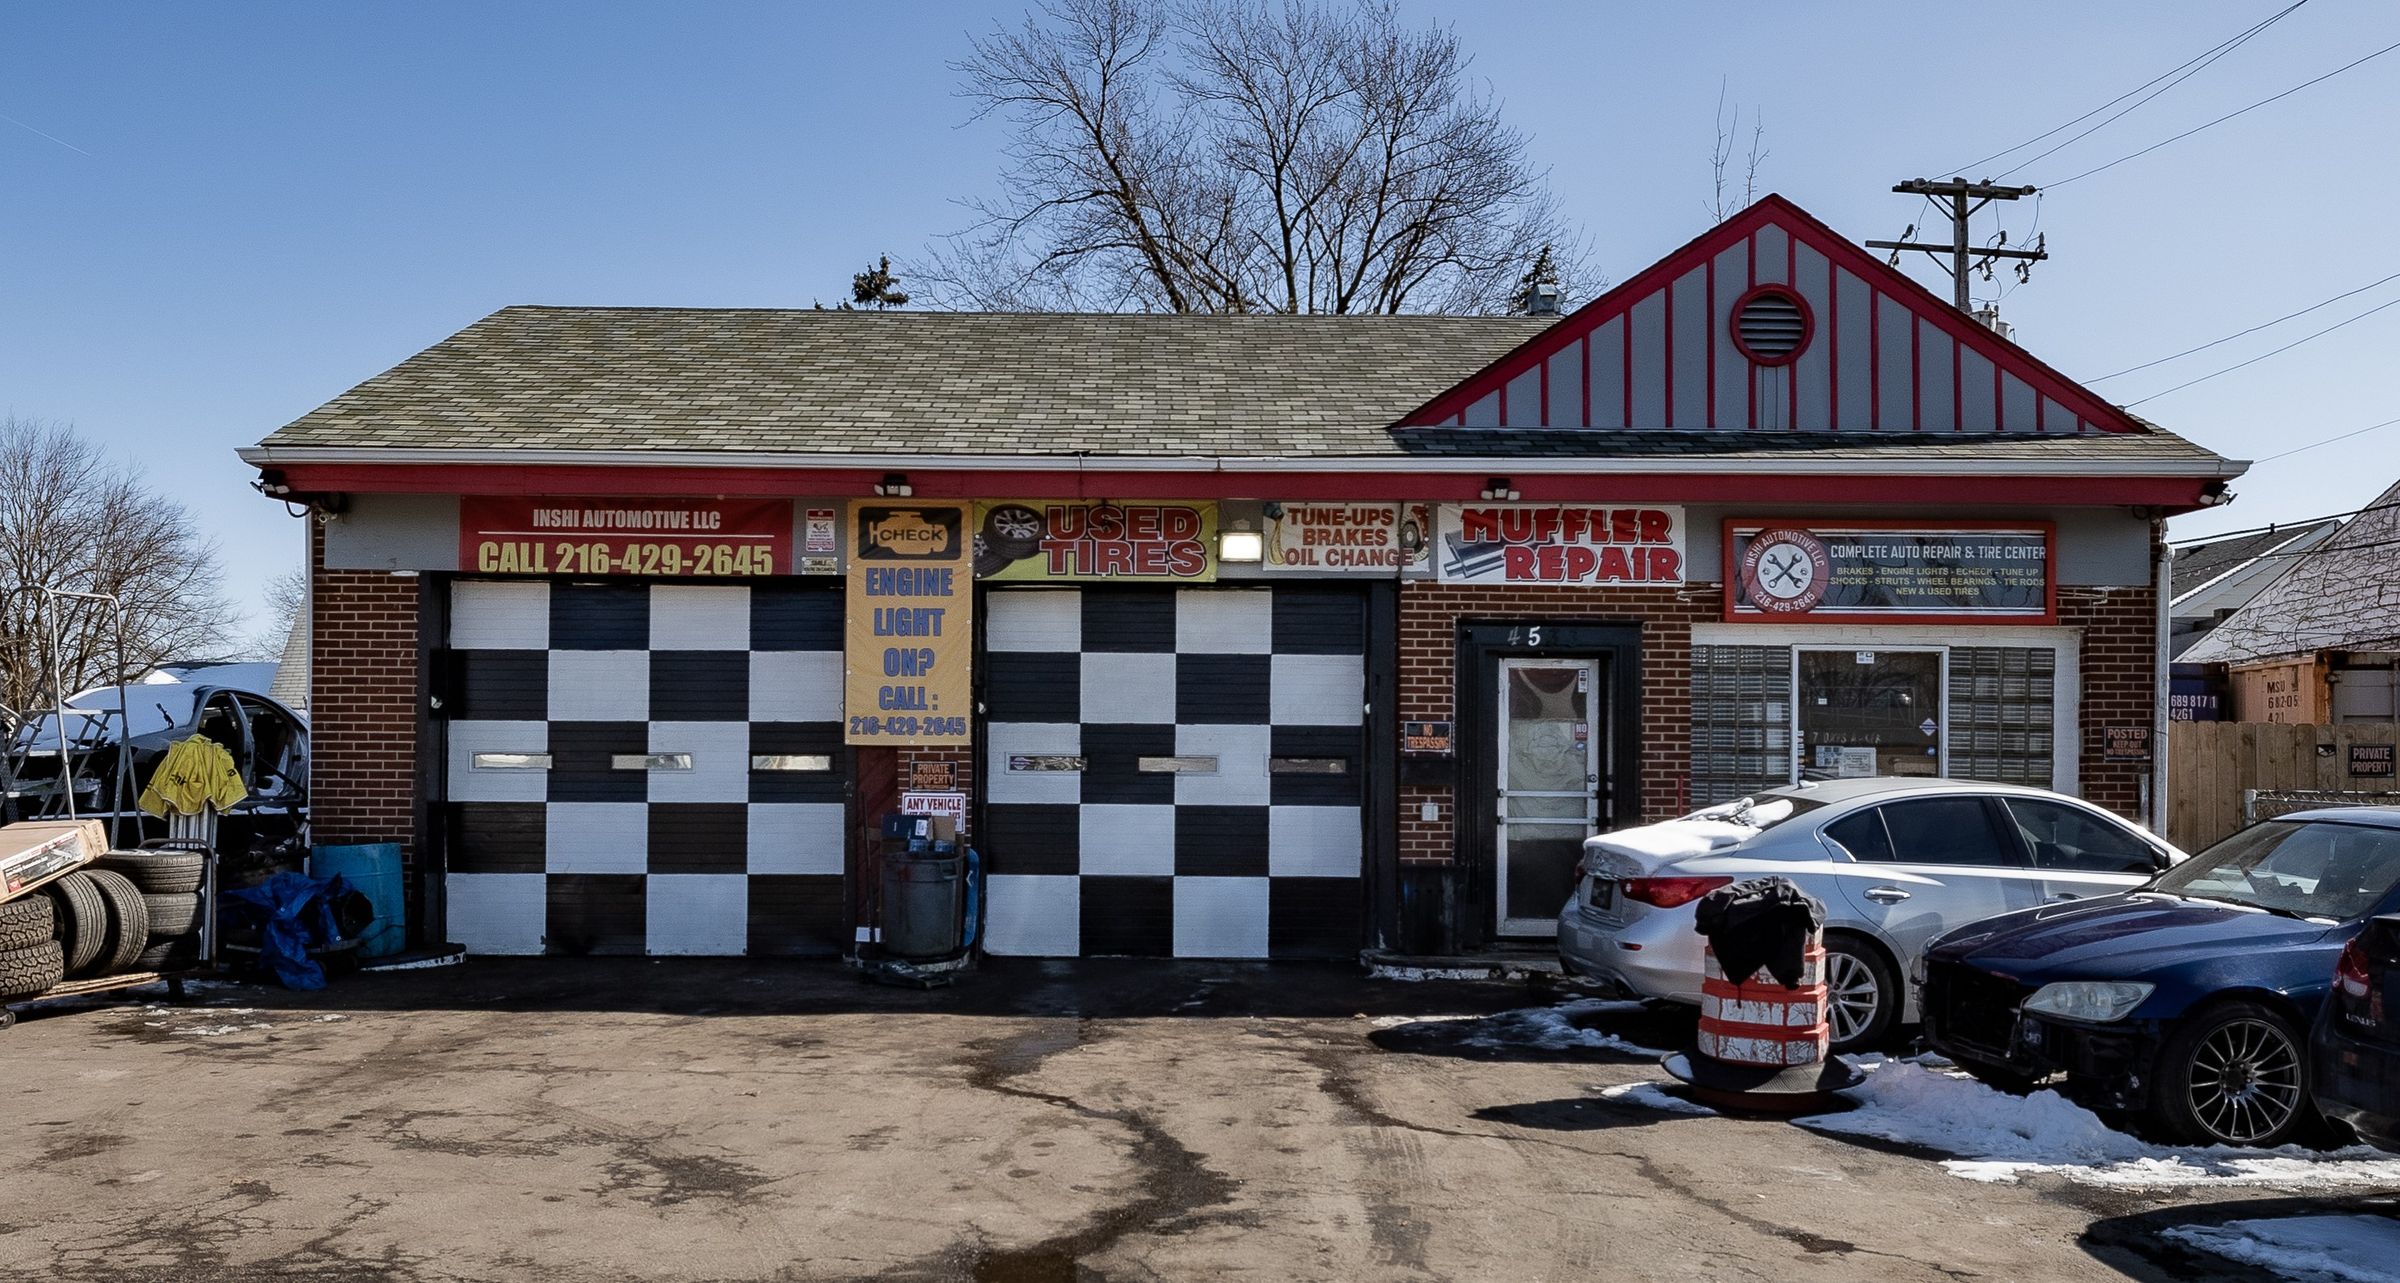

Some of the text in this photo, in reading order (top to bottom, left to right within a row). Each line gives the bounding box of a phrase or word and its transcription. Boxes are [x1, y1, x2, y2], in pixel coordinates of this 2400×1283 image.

[533, 509, 721, 530] INSHI AUTOMOTIVE LLC
[1046, 505, 1201, 542] USED
[1287, 507, 1394, 526] TUNE-UPS
[879, 529, 943, 542] CHECK
[1461, 508, 1673, 545] MUFFLER
[1302, 528, 1388, 546] BRAKES
[478, 541, 773, 575] CALL 216-429-2645
[1039, 539, 1207, 577] TIRES
[1285, 548, 1414, 566] OIL CHANGE
[1746, 531, 1825, 567] INSHI AUTOMOTIVE LLC
[1830, 545, 2046, 560] COMPLETE AUTO REPAIR & TIRE CENTER
[1502, 546, 1683, 583] REPAIR
[1837, 567, 1874, 575] BRAKES
[1881, 567, 1914, 575] ENGINE
[1916, 567, 1949, 576] LIGHTS
[1956, 568, 1993, 576] ECHECK
[2000, 568, 2024, 576] TUNE
[2026, 568, 2039, 576] UP
[865, 567, 954, 596] ENGINE
[1830, 577, 1867, 585] SHOCKS
[1875, 577, 1910, 585] STRUTS
[1917, 577, 1949, 585] WHEEL
[1950, 578, 1996, 586] BEARINGS
[2004, 578, 2018, 586] TIE
[2020, 578, 2045, 586] RODS
[1896, 587, 1916, 595] NEW
[1927, 587, 1952, 595] USED
[1954, 587, 1980, 596] TIRES
[1754, 591, 1815, 612] 216-429-2645
[873, 608, 945, 637] LIGHT
[883, 648, 935, 677] ON?
[849, 716, 967, 736] 216-429-2645
[1423, 724, 1432, 736] NO
[2108, 729, 2148, 739] POSTED
[1408, 736, 1449, 749] TRESPASSING
[2353, 747, 2390, 760] PRIVATE
[918, 764, 950, 774] PRIVATE
[2351, 762, 2392, 773] PROPERTY
[912, 774, 954, 785] PROPERTY
[907, 798, 961, 810] ANY VEHICLE
